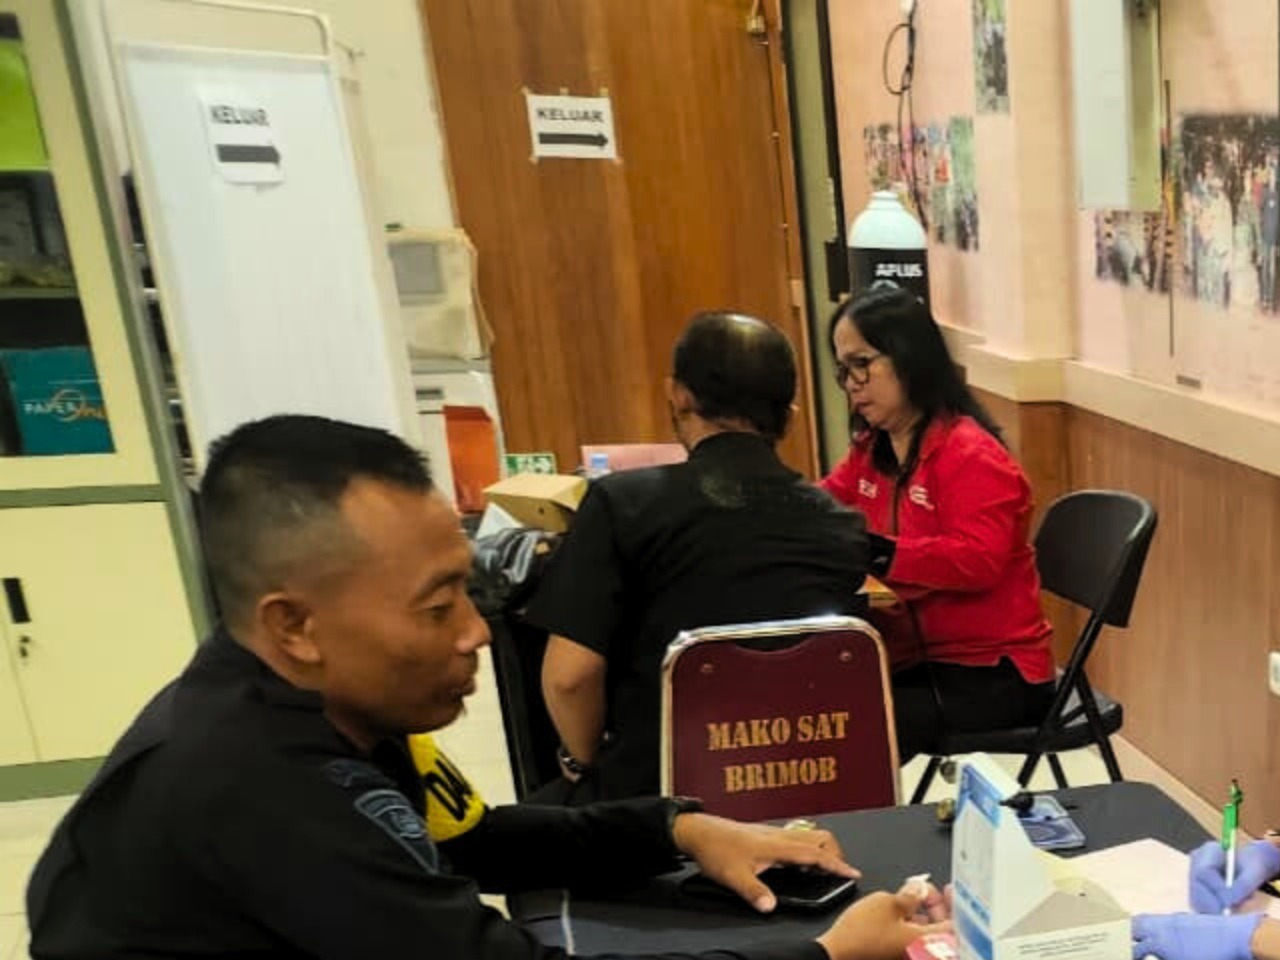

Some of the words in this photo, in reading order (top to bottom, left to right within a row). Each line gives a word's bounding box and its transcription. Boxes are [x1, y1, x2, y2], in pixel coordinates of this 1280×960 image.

[210, 105, 269, 126] KELUAR
[537, 108, 603, 123] KELUAR
[706, 717, 791, 751] MAKO
[797, 711, 849, 743] SAT
[723, 755, 837, 793] BRIMOB
